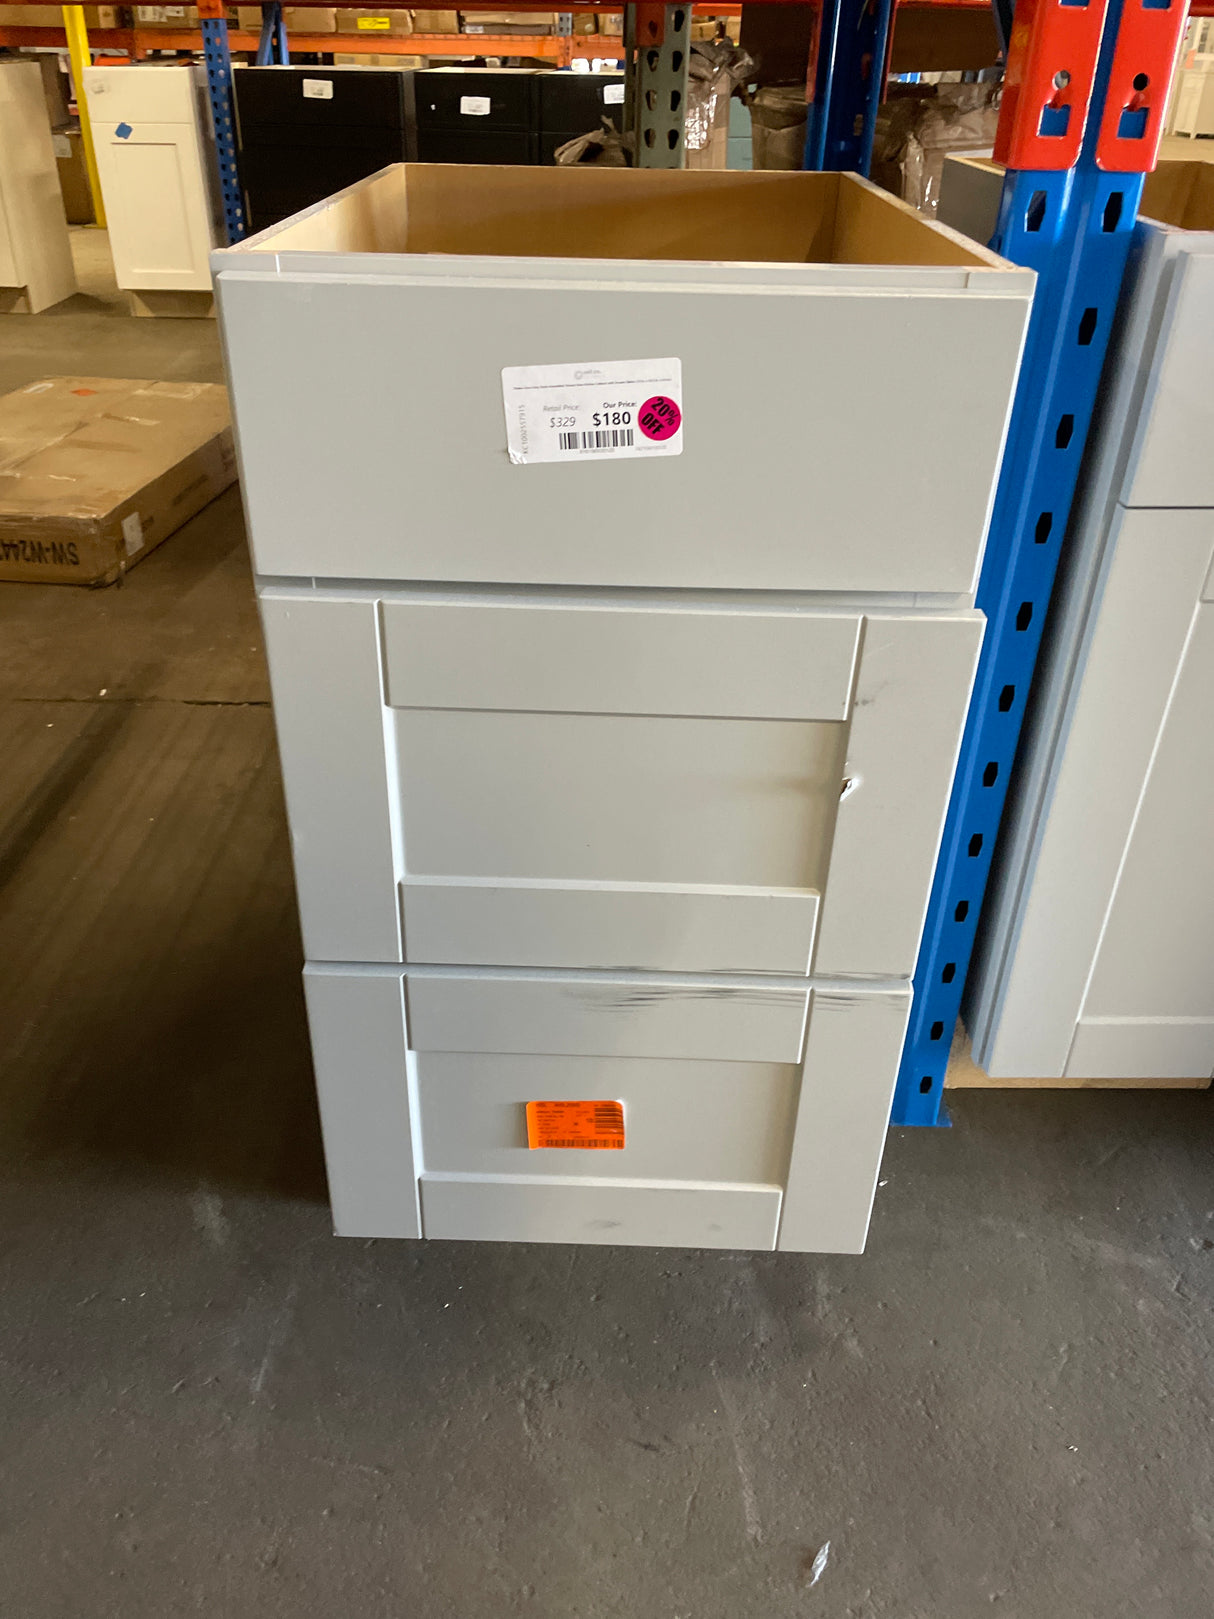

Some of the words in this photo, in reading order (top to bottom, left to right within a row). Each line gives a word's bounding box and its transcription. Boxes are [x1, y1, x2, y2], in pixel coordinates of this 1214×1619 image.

[592, 411, 631, 427] $180
[651, 397, 678, 426] 20%
[549, 416, 576, 428] $329
[641, 412, 665, 435] OFF
